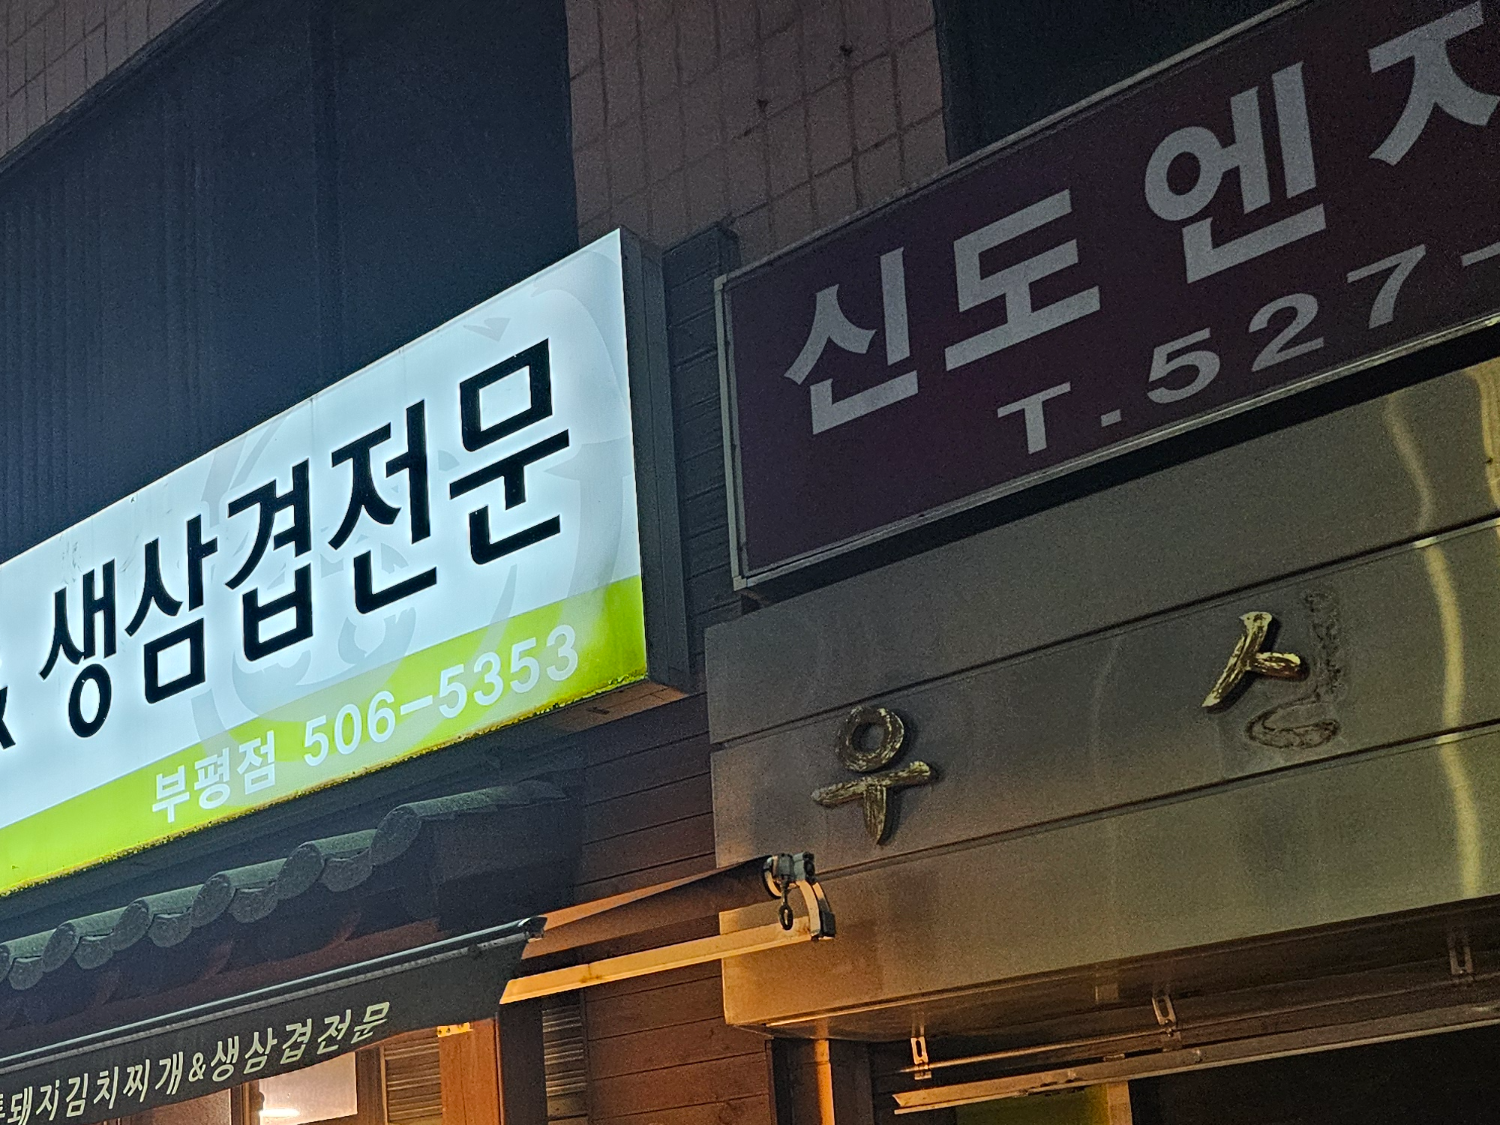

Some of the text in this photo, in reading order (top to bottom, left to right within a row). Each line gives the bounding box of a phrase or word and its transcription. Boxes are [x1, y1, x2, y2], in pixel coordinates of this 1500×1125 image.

[40, 337, 570, 738] 생삼겹전문
[151, 623, 579, 823] 부평점 506-5353
